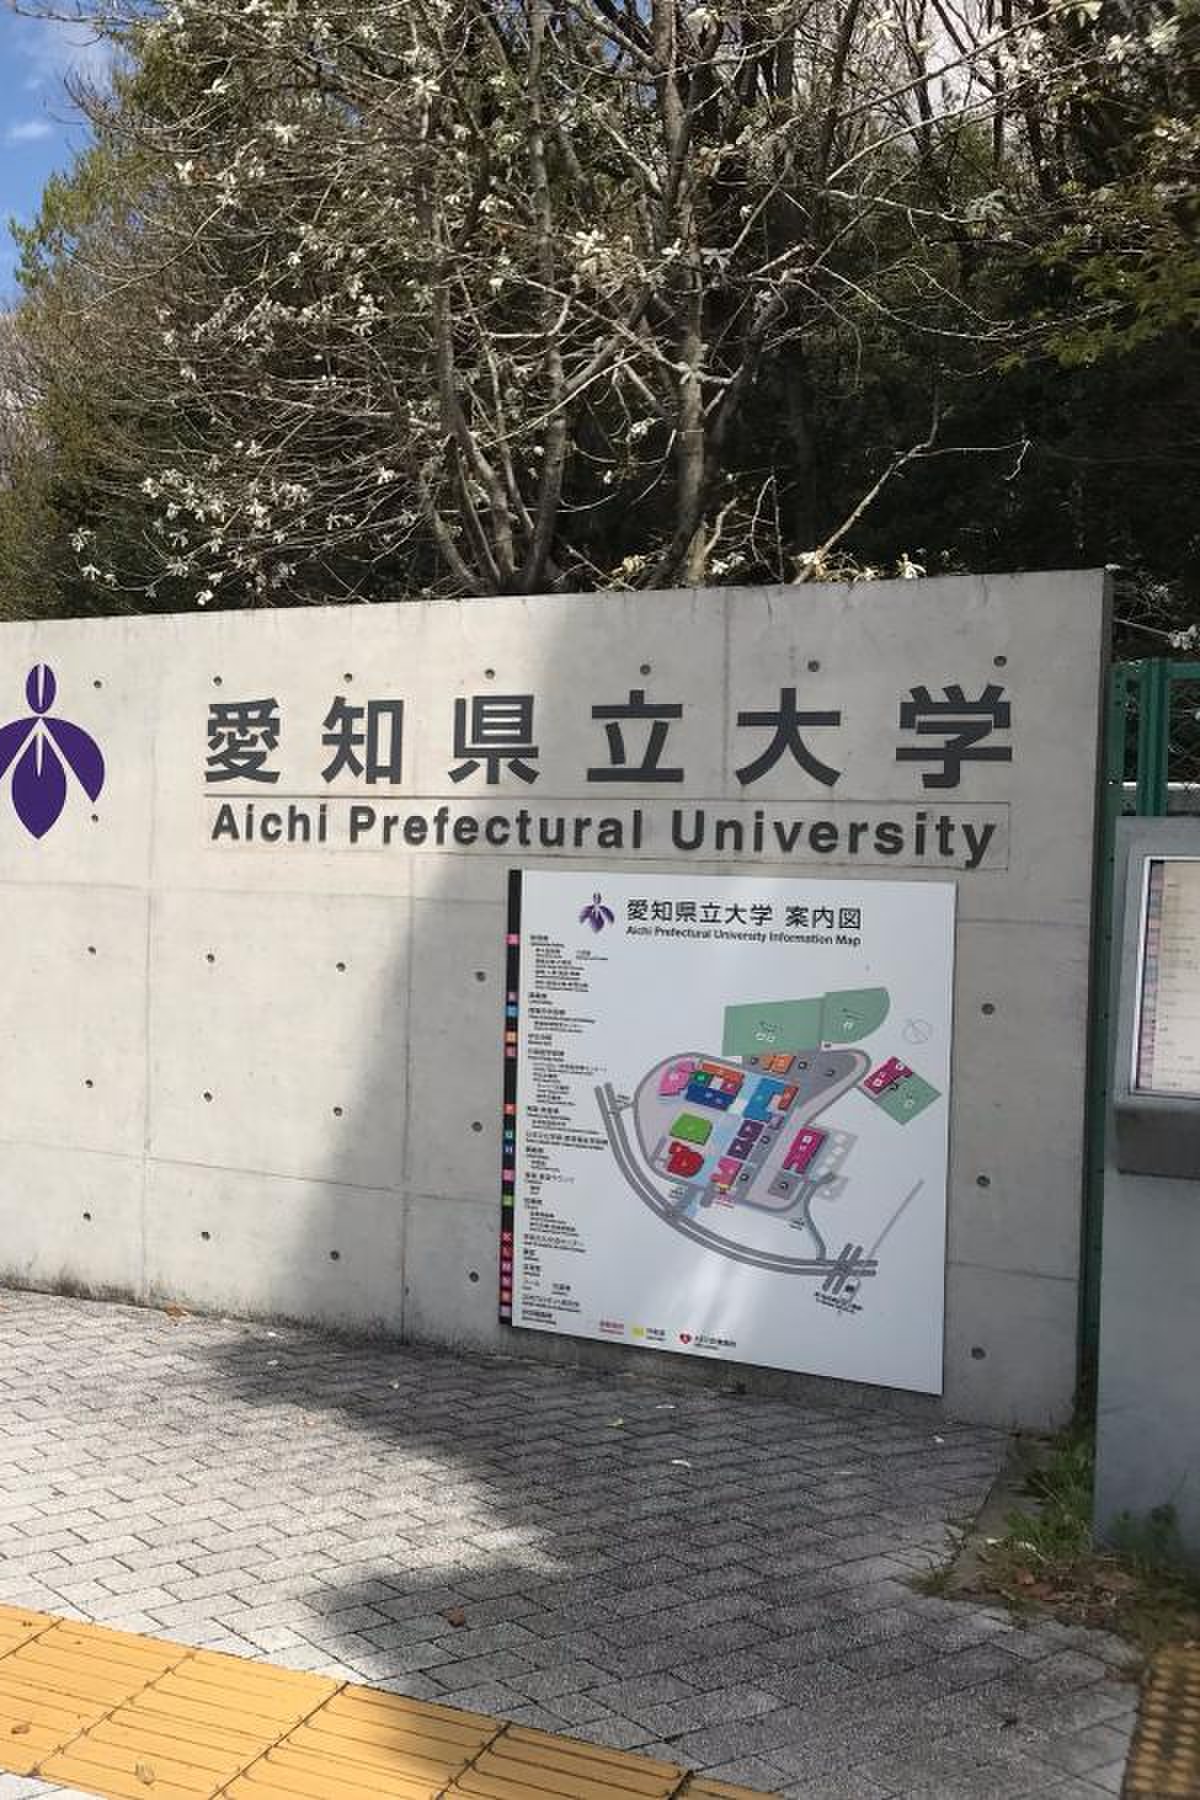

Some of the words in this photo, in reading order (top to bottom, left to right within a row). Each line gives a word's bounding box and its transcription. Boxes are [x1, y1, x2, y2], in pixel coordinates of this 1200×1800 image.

[204, 684, 1013, 789] 愛知県立大学
[211, 803, 328, 844] Aichi
[349, 805, 643, 848] Prefectural
[671, 809, 996, 869] University
[626, 926, 652, 936] Aichi
[654, 926, 711, 940] Prefectural
[714, 929, 767, 943] University
[769, 931, 833, 946] Information
[835, 934, 861, 948] Map
[627, 899, 773, 927] 愛知県立大学
[785, 905, 861, 930] 案内図
